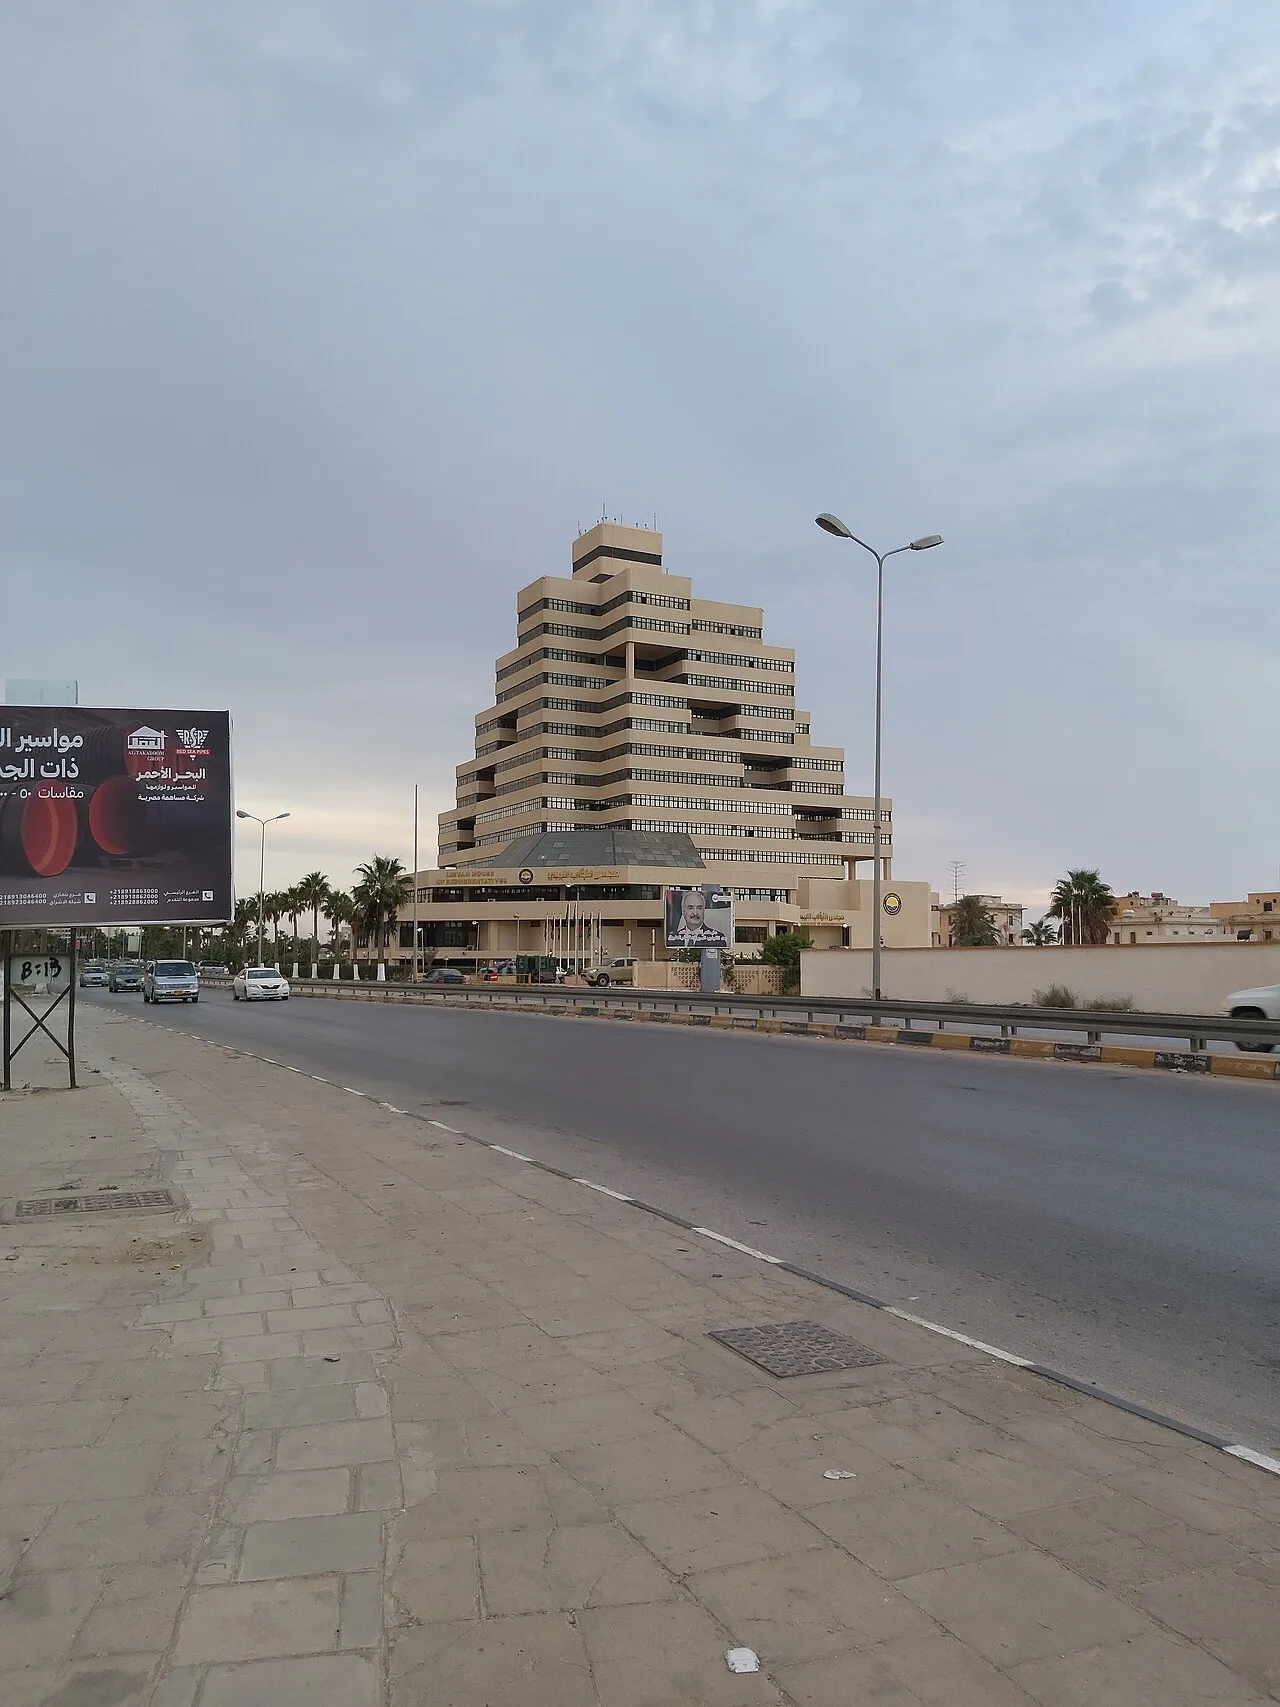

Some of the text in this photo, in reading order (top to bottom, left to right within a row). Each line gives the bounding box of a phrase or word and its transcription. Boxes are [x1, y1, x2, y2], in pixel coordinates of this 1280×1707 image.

[0, 727, 84, 753] مواسير ال
[184, 727, 204, 747] RSP
[0, 757, 79, 781] ذات الج
[135, 765, 171, 782] الأحمر
[38, 786, 84, 799] مقاسات
